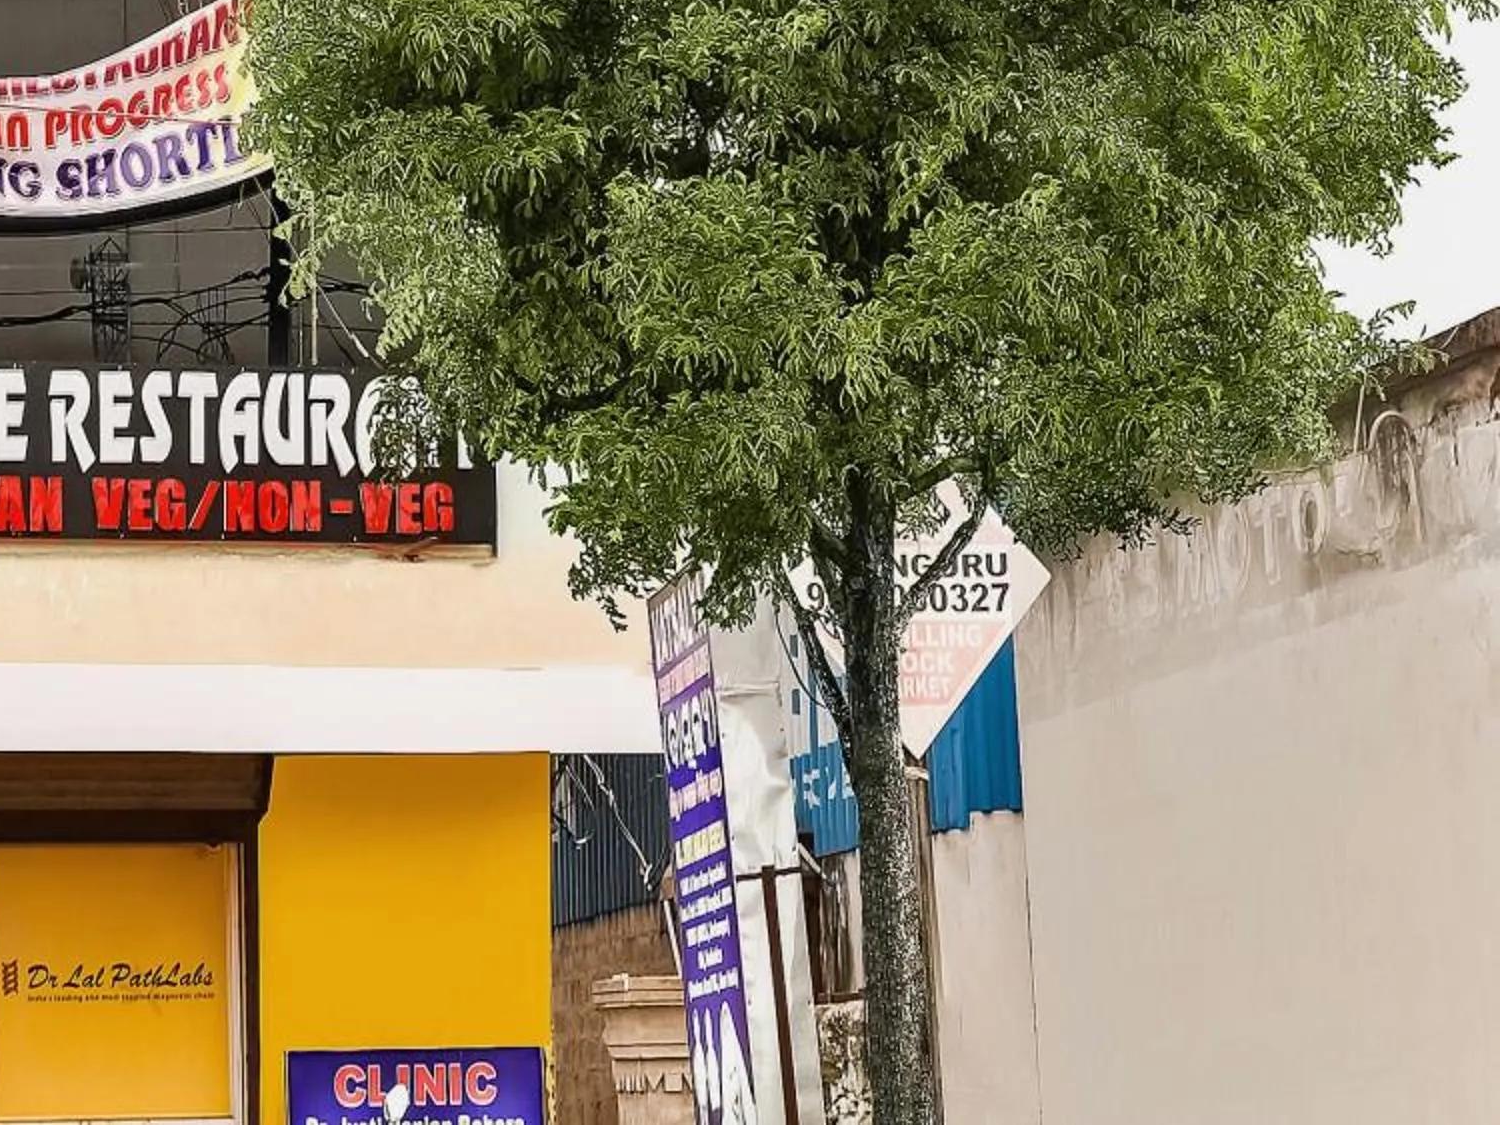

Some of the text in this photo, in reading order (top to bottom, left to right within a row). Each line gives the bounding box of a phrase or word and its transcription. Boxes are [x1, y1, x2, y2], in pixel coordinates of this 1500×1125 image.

[45, 62, 231, 150] PROGRESS
[27, 962, 213, 989] Dr Lal PathLabs
